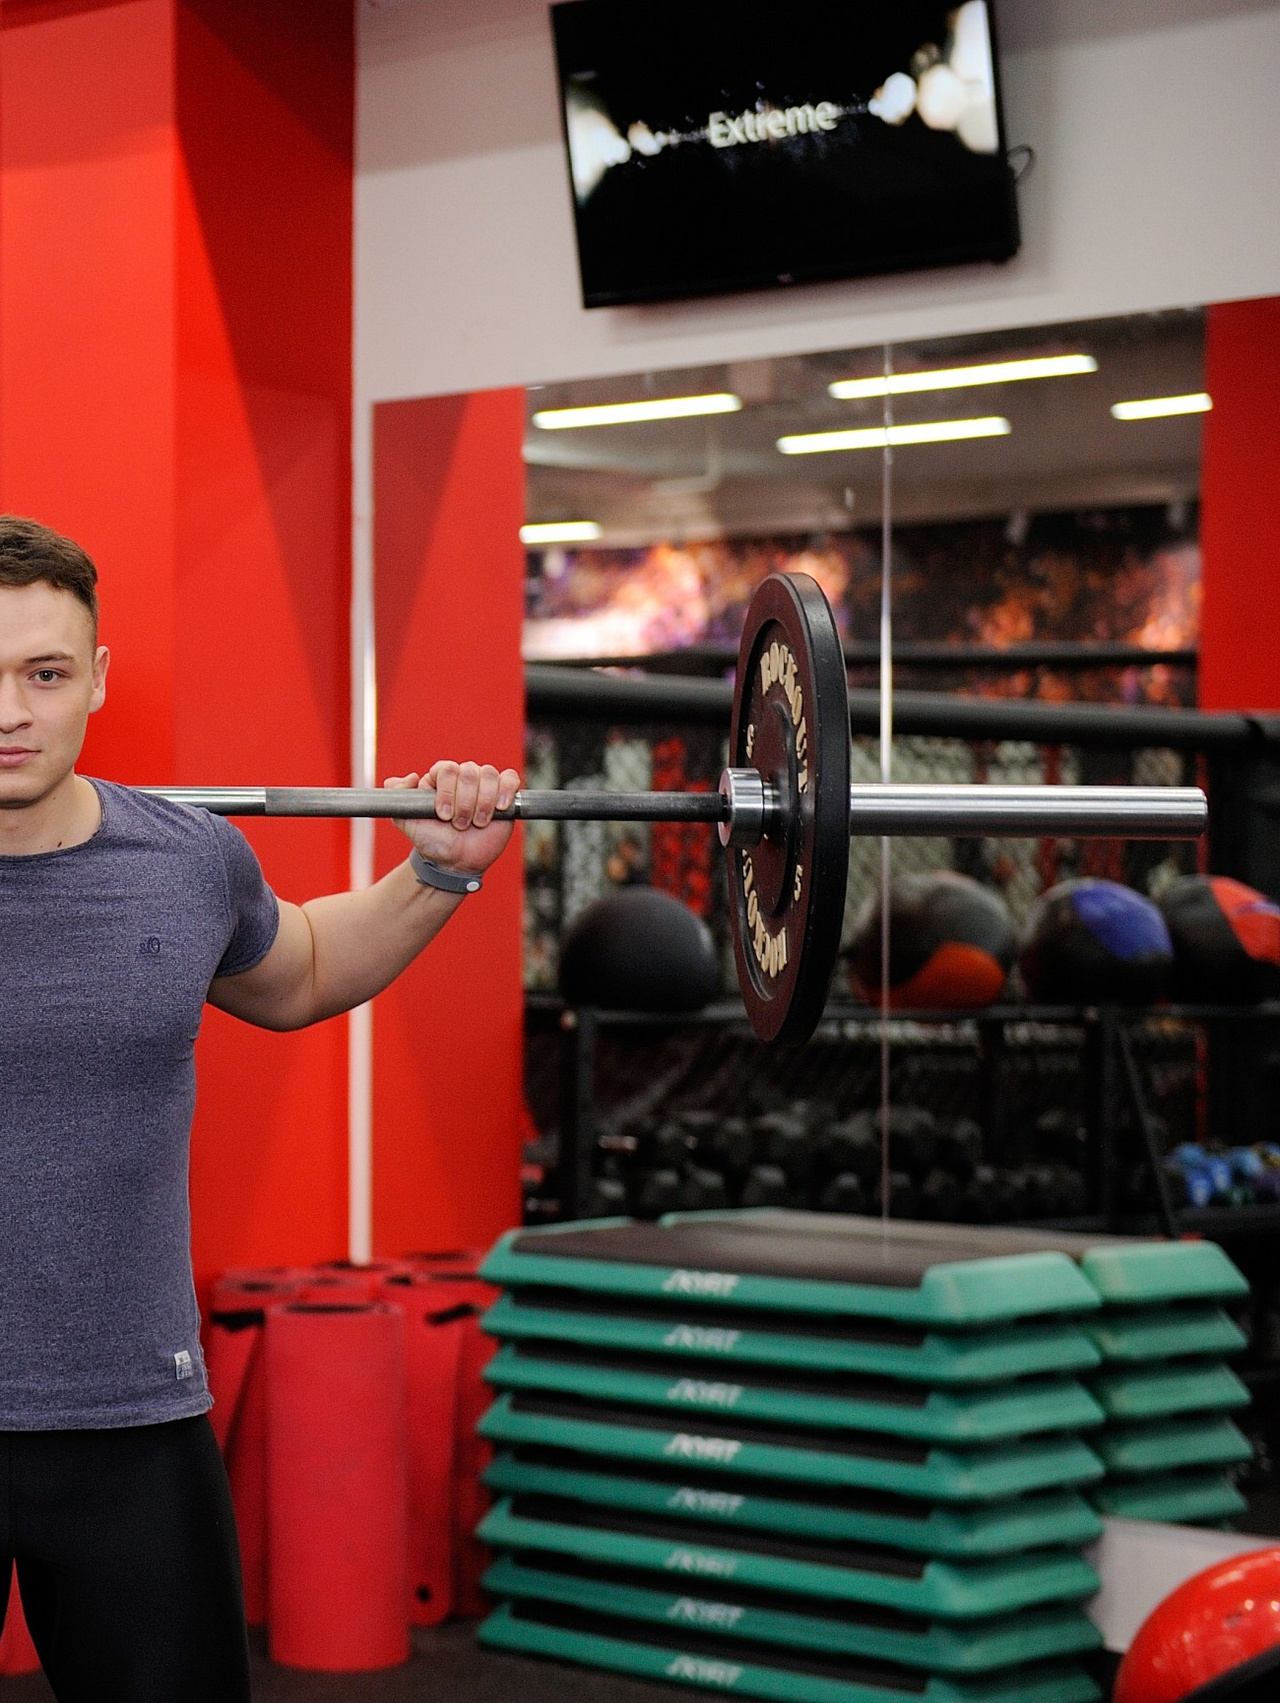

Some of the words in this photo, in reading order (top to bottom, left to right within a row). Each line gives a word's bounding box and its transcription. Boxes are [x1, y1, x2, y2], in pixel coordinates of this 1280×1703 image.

[709, 101, 838, 149] Extreme
[760, 641, 808, 794] ROCKOUT
[742, 849, 789, 978] ROCKOU
